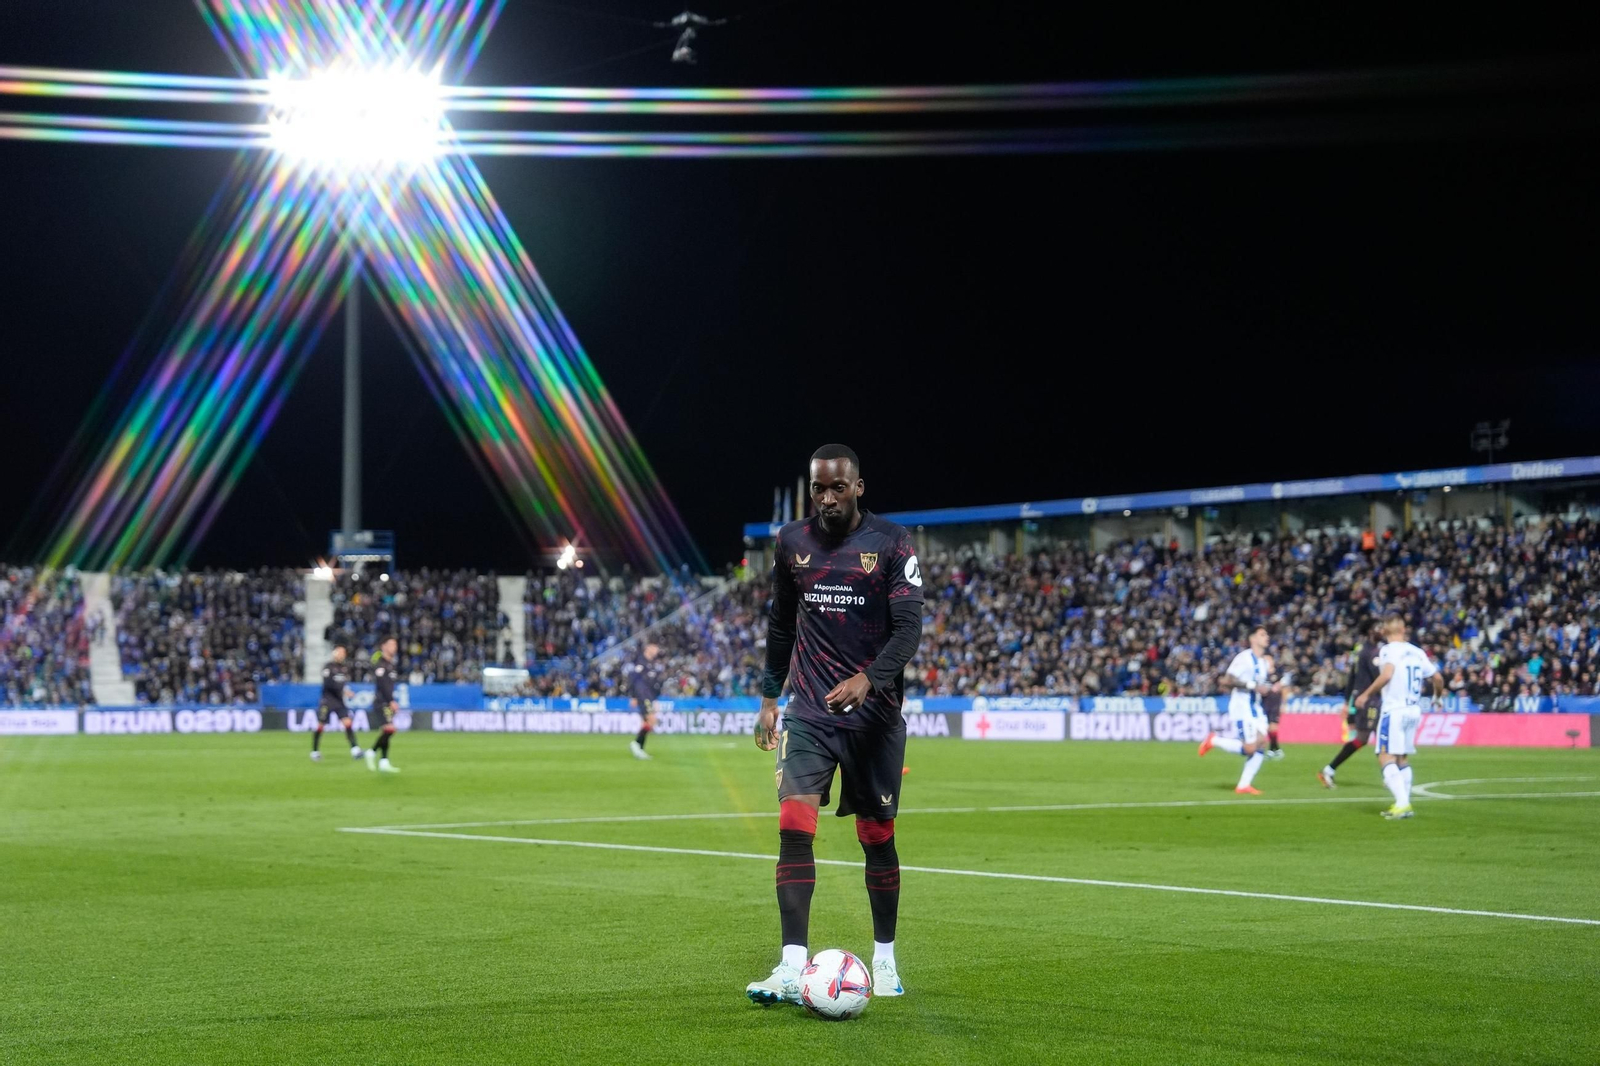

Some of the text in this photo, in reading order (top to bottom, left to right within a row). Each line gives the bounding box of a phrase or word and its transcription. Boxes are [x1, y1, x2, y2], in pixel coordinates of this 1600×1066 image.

[804, 592, 865, 605] BIZUM 02910
[813, 583, 853, 592] #ApoyoDANA
[1406, 665, 1421, 694] 15
[84, 710, 262, 733] BIZUM 02910
[688, 712, 720, 734] LOS
[1070, 713, 1150, 740] BIZUM
